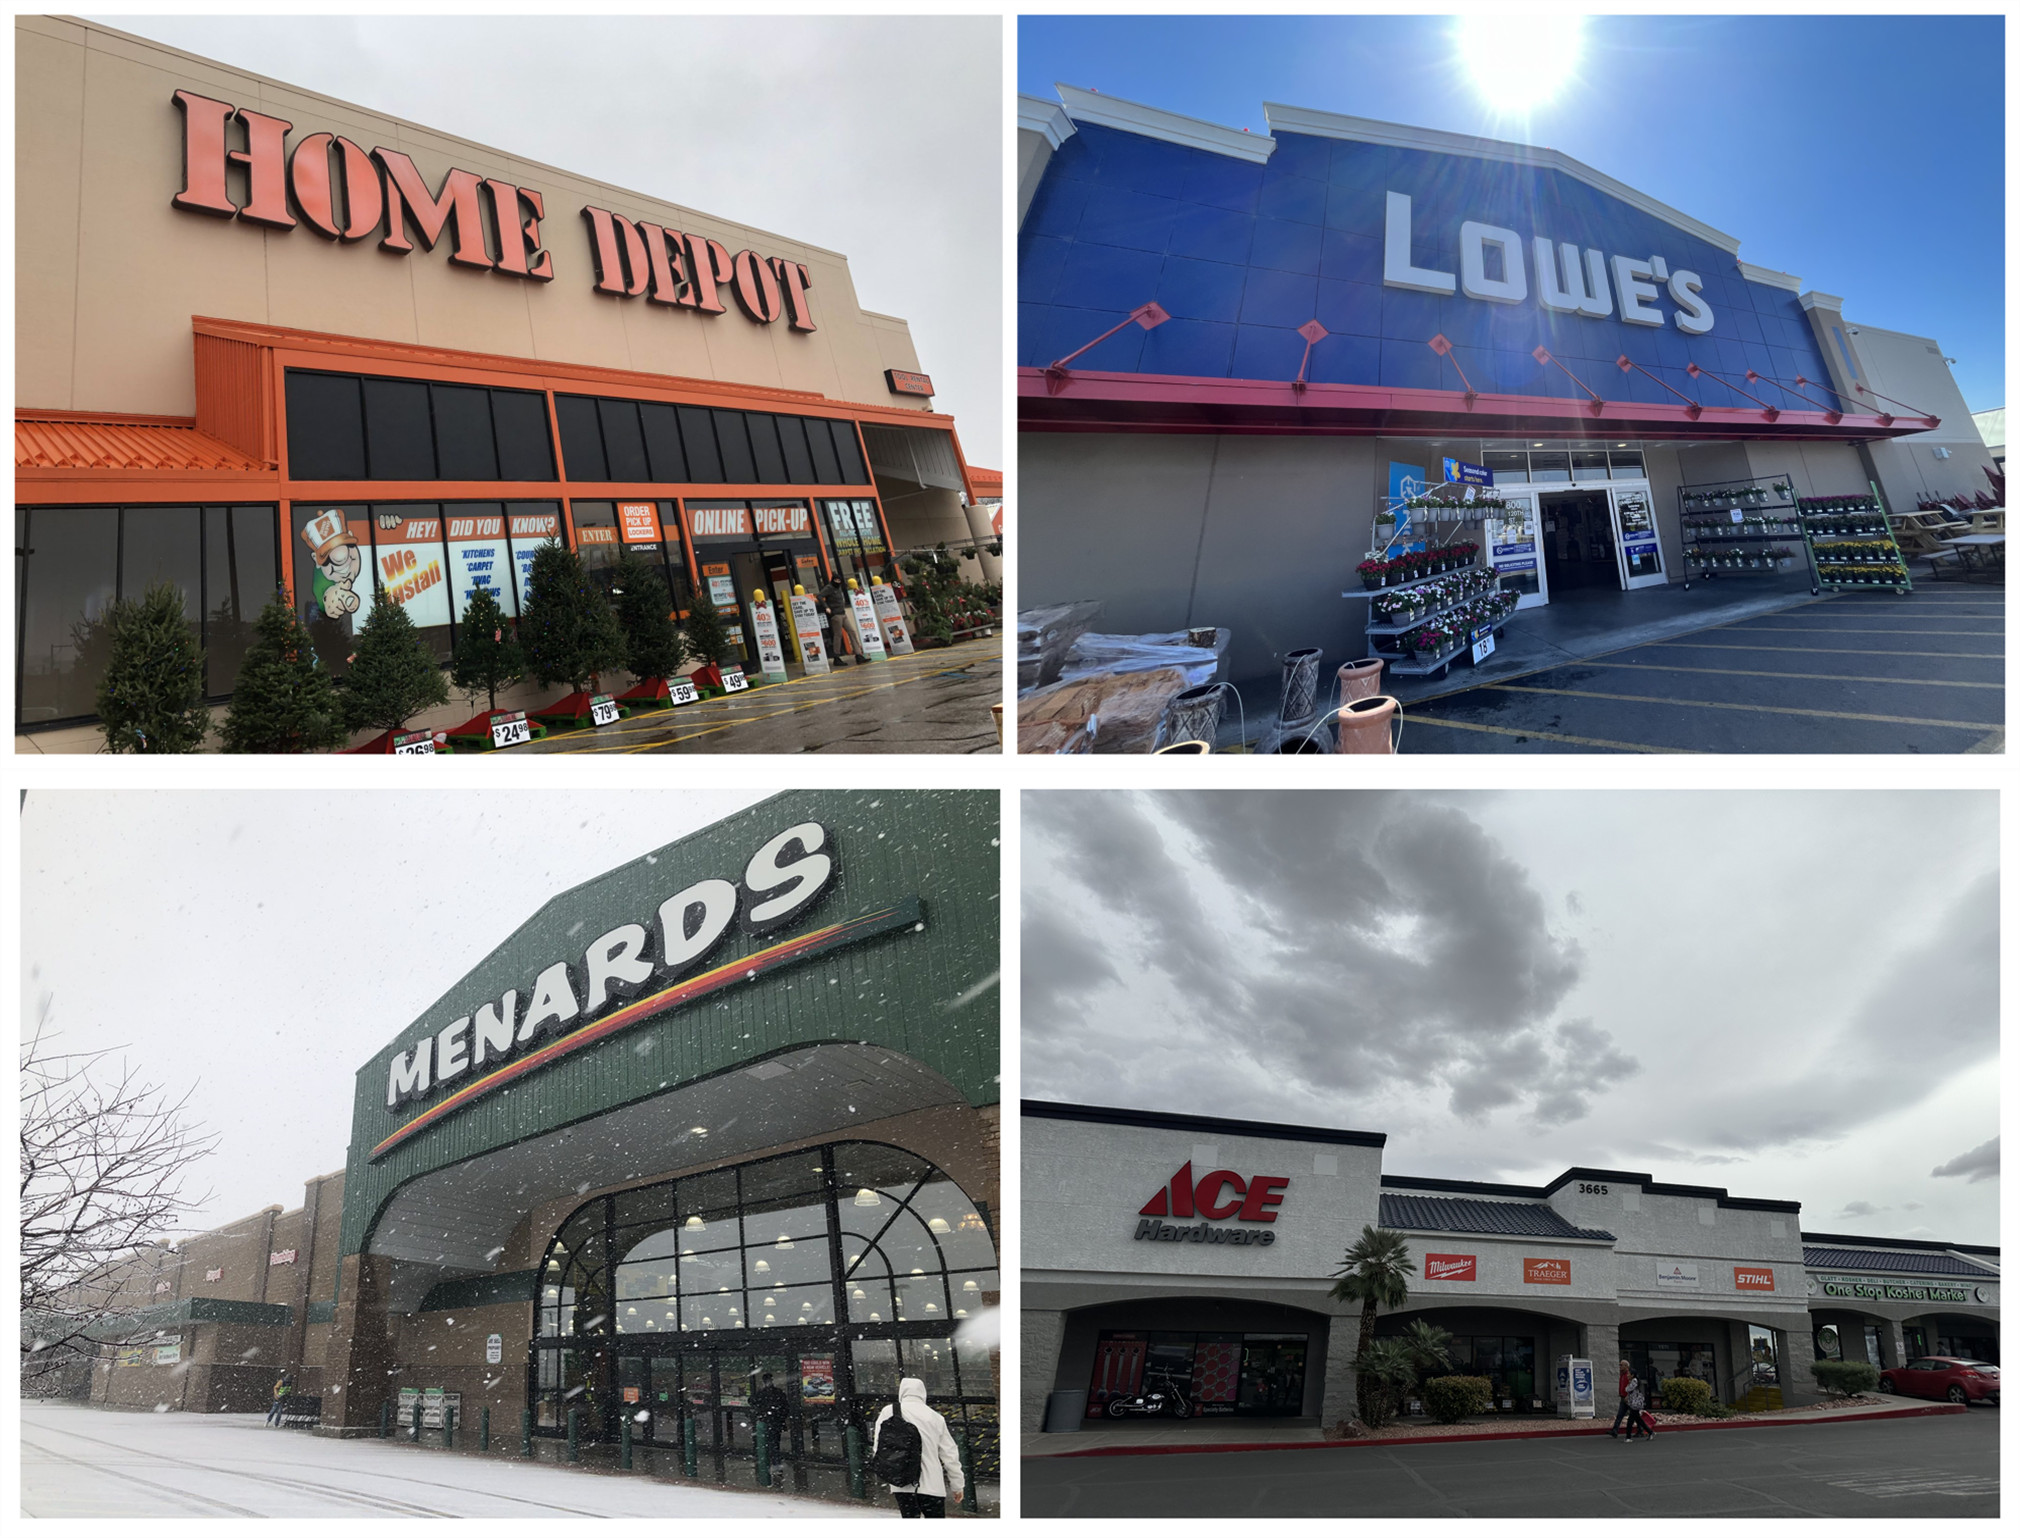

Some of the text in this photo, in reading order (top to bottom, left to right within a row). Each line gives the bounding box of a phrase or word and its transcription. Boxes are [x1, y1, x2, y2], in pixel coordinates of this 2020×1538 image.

[171, 88, 817, 334] HOME DEPOT
[1384, 190, 1715, 335] LOWE'S
[623, 506, 651, 516] ORDER
[1506, 501, 1521, 509] 800
[626, 517, 651, 526] PICK UP
[694, 508, 808, 535] ONLINE PICK-UP
[828, 502, 873, 530] FREE
[406, 521, 438, 539] HEY!
[450, 520, 474, 537] DID
[476, 518, 501, 535] YOU
[582, 529, 613, 542] ENTER
[381, 549, 417, 582] We
[708, 565, 724, 575] Enter
[387, 820, 834, 1110] MENARDS
[1138, 1159, 1290, 1223] ACE
[1579, 1183, 1608, 1195] 3665
[1134, 1219, 1276, 1246] Hardware
[1428, 1258, 1473, 1274] Milwaukee
[1528, 1269, 1567, 1279] TRAEGER
[1737, 1274, 1771, 1285] STIHL
[1824, 1282, 1969, 1301] One Stop Kosher Market
